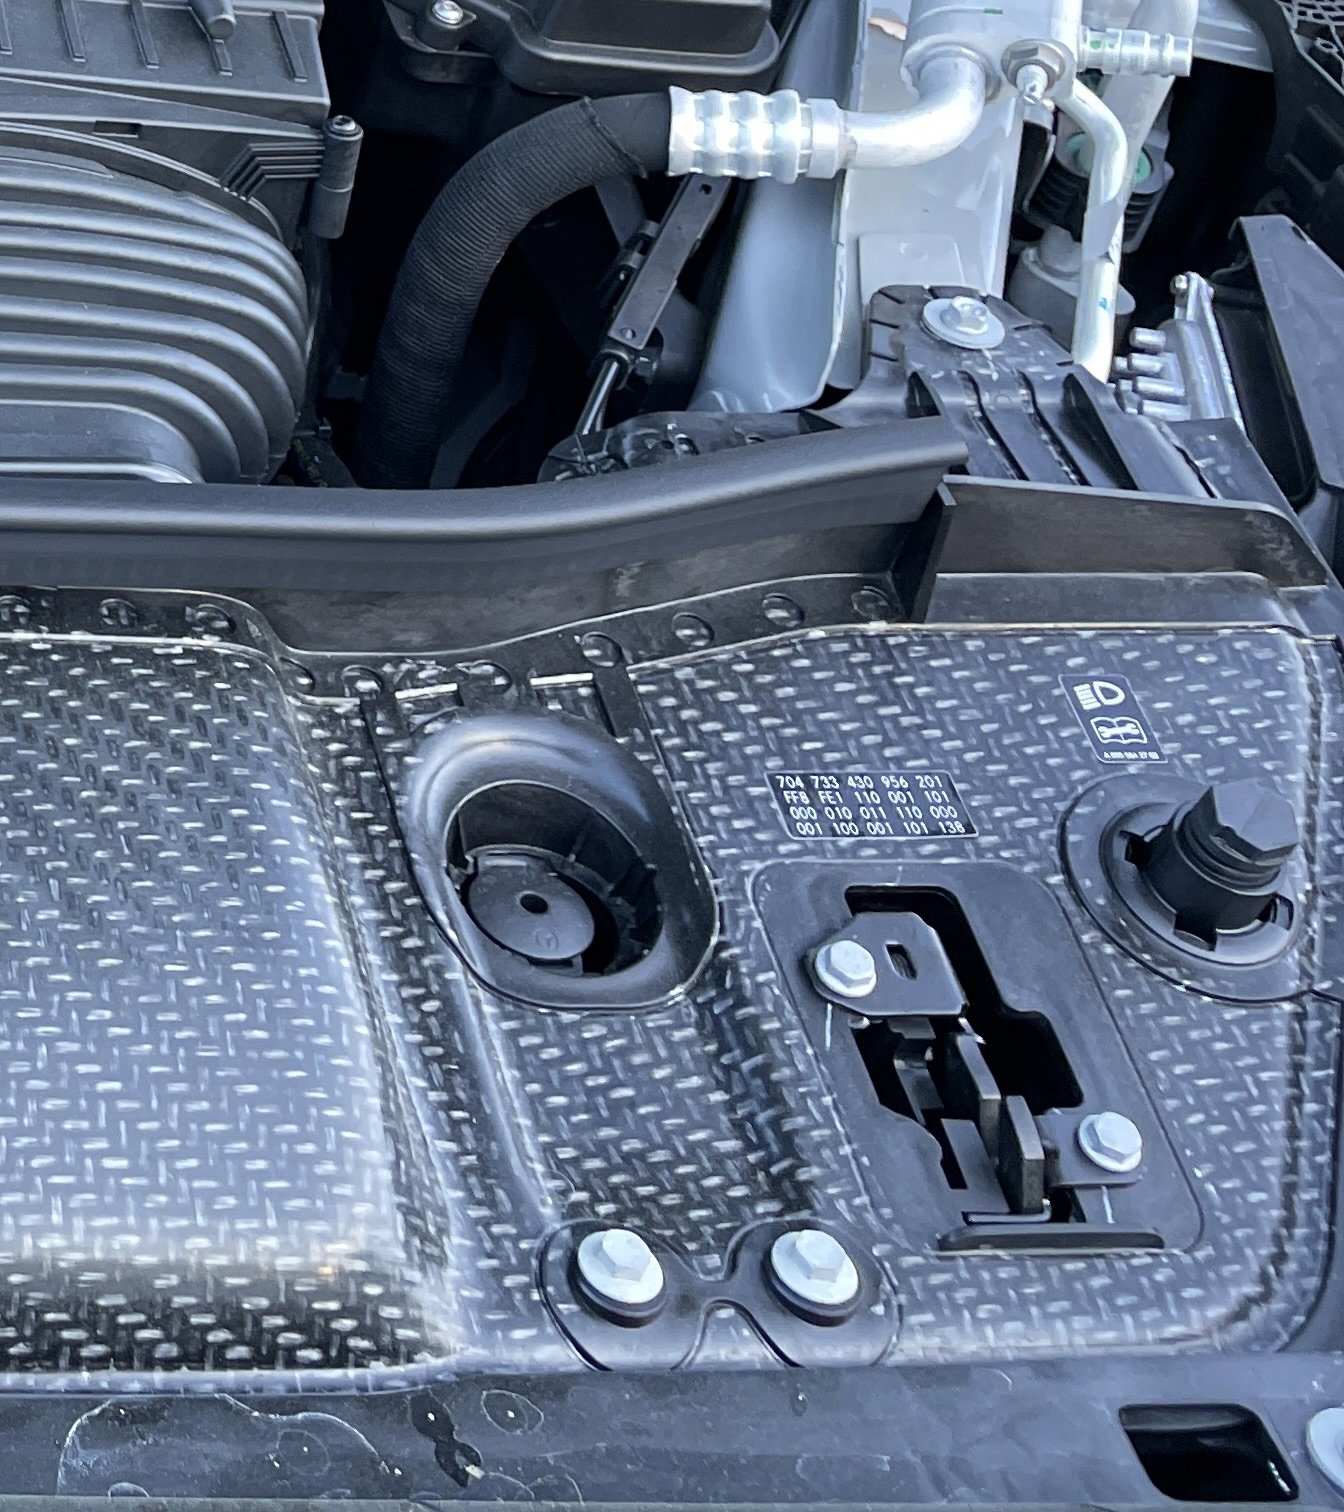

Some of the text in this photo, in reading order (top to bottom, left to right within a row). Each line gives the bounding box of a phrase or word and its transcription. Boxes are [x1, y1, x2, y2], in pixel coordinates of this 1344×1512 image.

[775, 775, 943, 789] 704 733 430 956 201
[817, 790, 844, 804] FE1
[854, 791, 881, 804] 110
[887, 790, 915, 804] 001
[924, 790, 950, 803] 101
[789, 805, 958, 820] 000 010 011 110 000
[796, 820, 966, 835] 001 100 001 101 138
